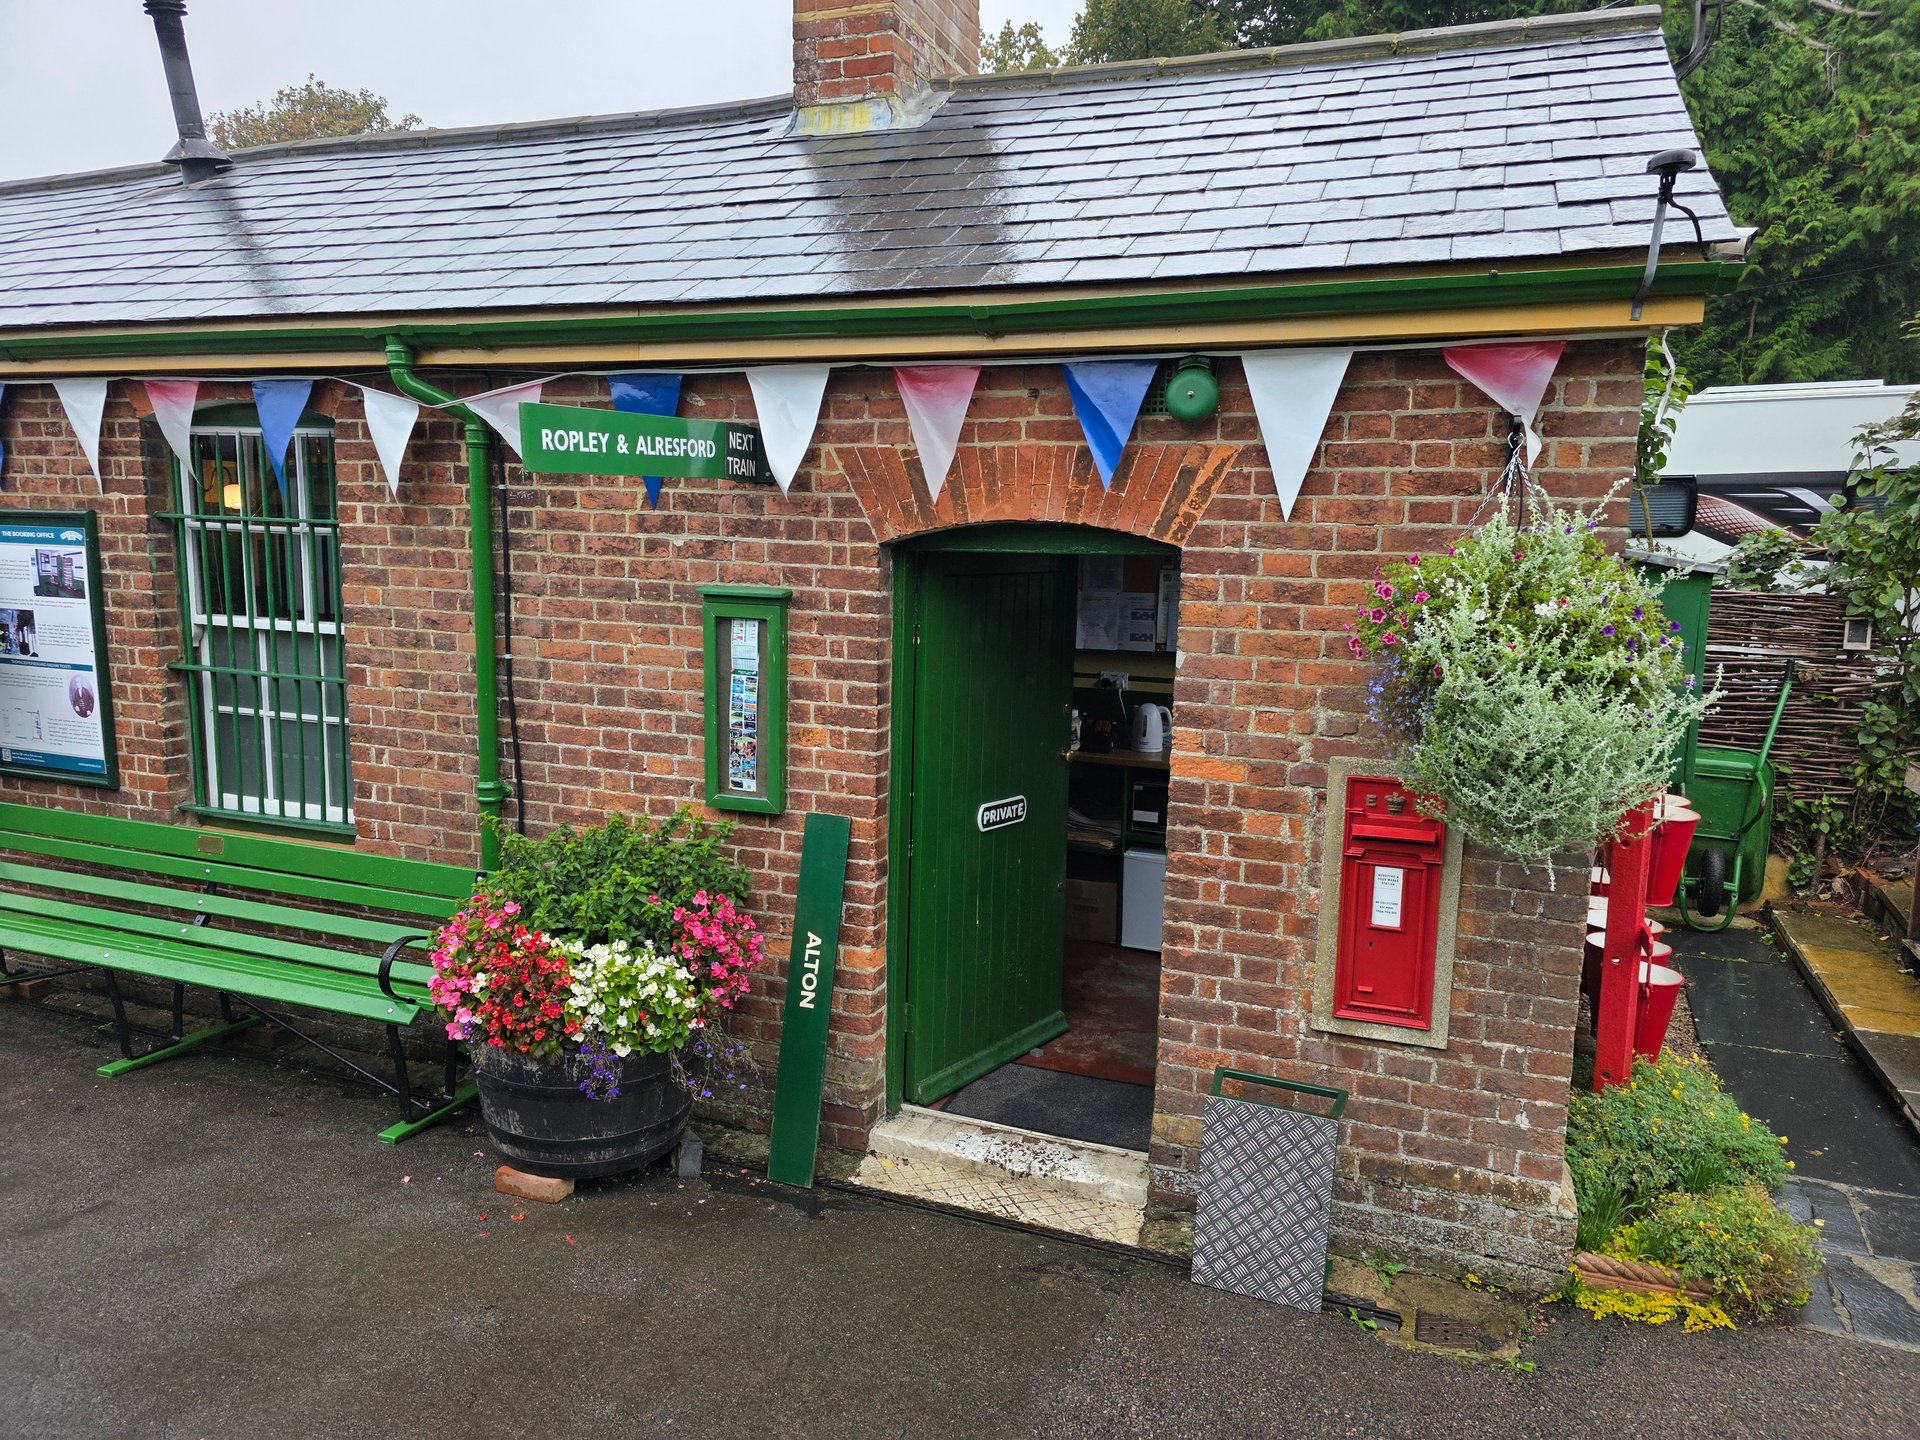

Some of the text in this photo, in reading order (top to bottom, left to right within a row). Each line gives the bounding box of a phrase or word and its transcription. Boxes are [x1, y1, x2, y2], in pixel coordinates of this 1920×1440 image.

[541, 428, 716, 459] ROPLEY & ALRESFORD
[728, 431, 755, 452] NEXT
[726, 456, 756, 477] TRAIN
[1366, 794, 1377, 807] E
[983, 802, 1024, 824] PRIVATE
[799, 931, 822, 1009] ALTON
